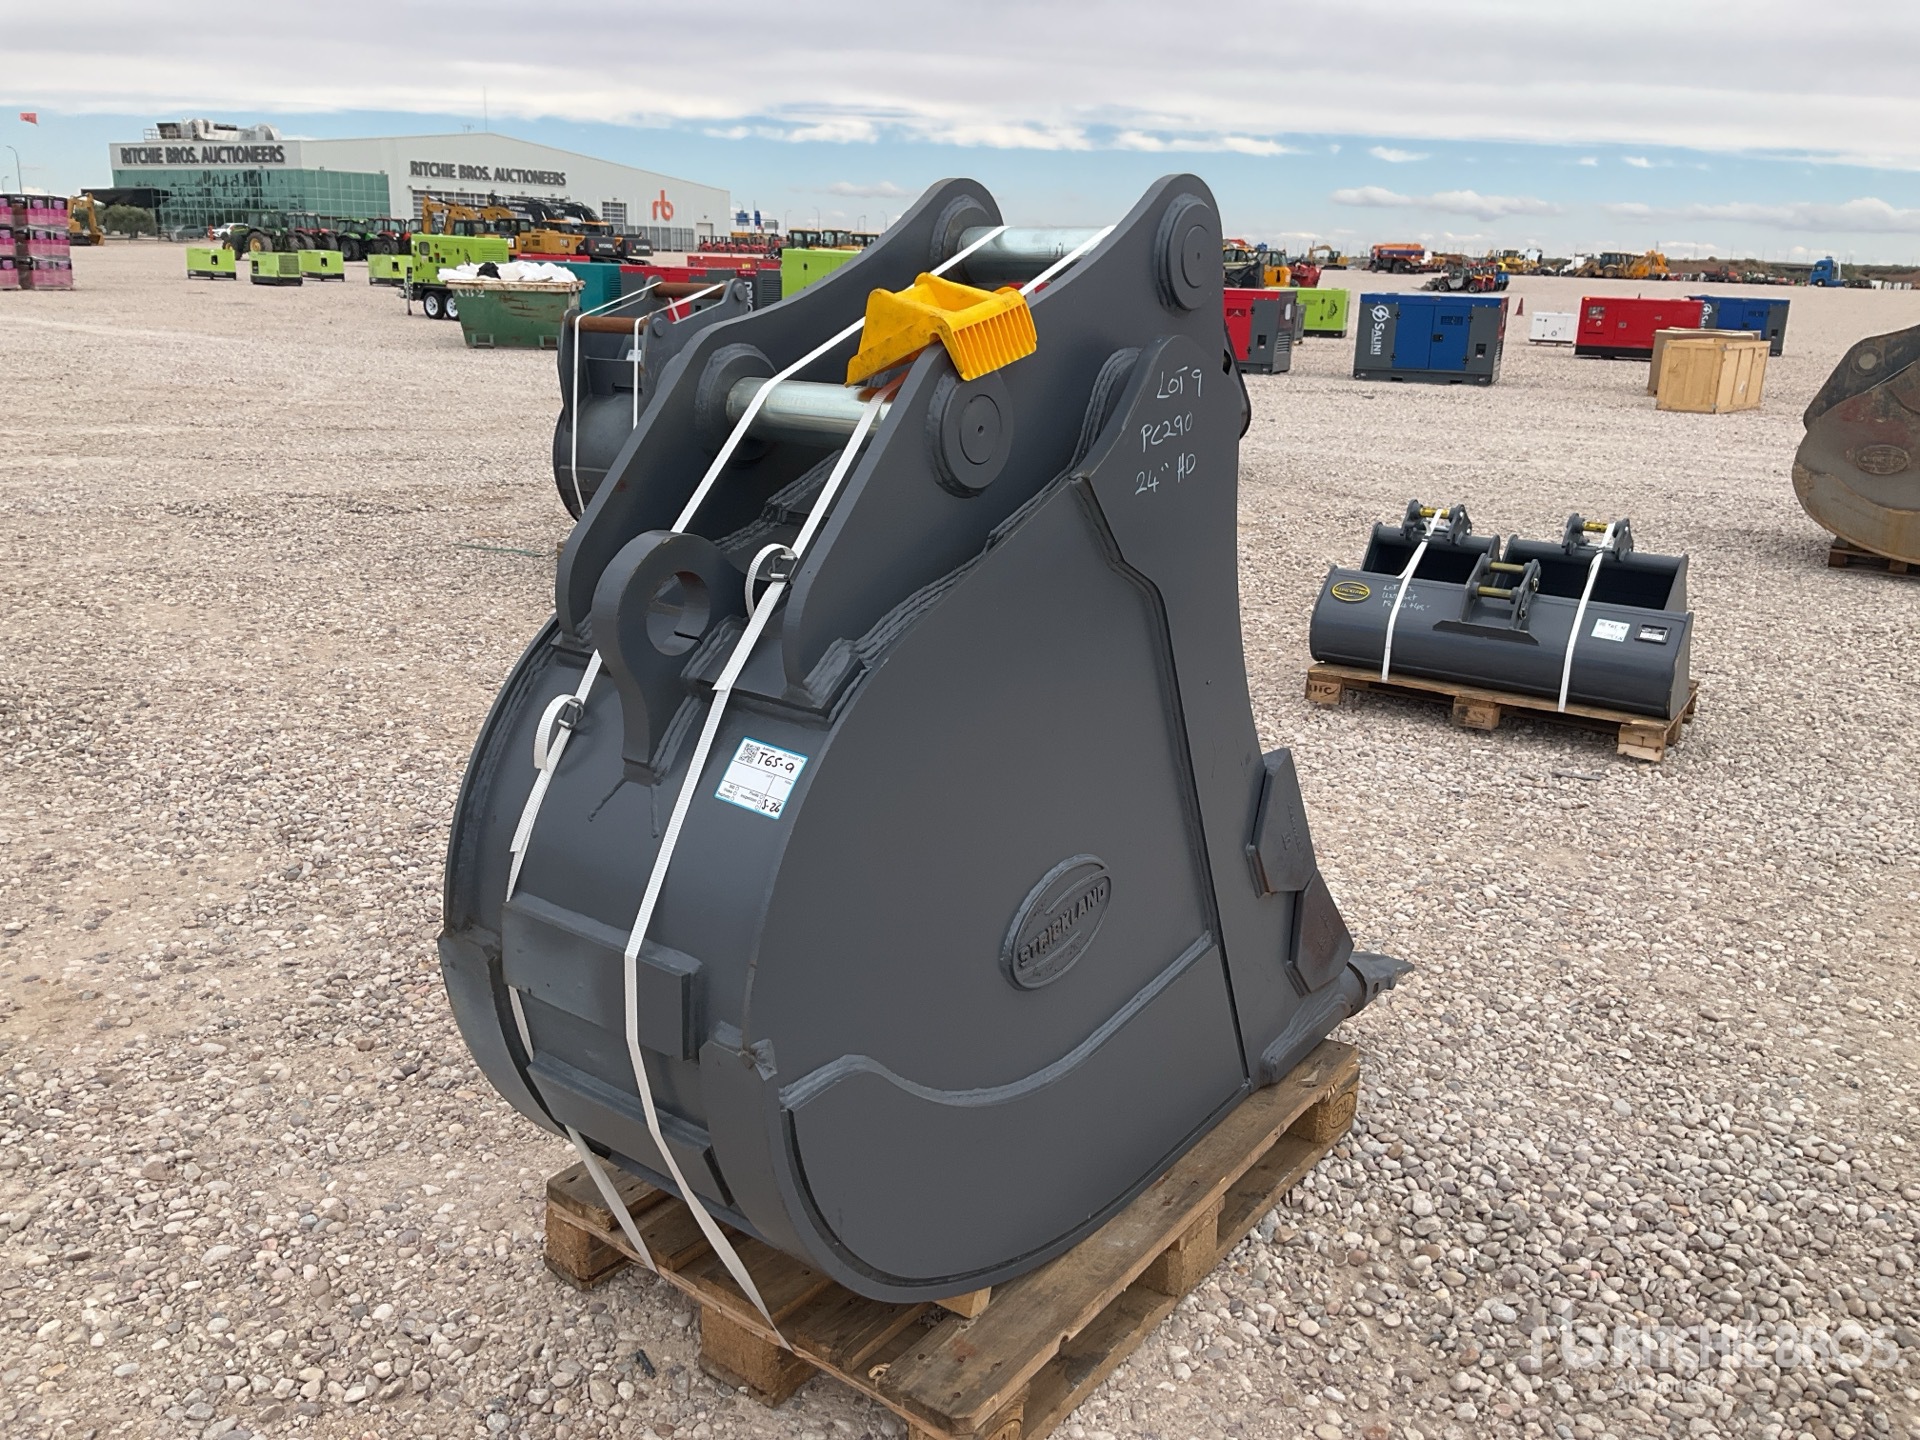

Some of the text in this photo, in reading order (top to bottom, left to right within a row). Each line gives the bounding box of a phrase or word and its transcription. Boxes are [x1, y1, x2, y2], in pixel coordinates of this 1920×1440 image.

[120, 145, 285, 164] RITCHIE BROS. AUCTIONEERS
[410, 160, 566, 186] RITCHIE BROS. AUCTIONEERS
[652, 189, 674, 221] rb
[1373, 322, 1385, 355] SALINI
[1156, 365, 1202, 399] LOT 9
[1140, 410, 1193, 453] PC290
[1177, 452, 1197, 483] HD
